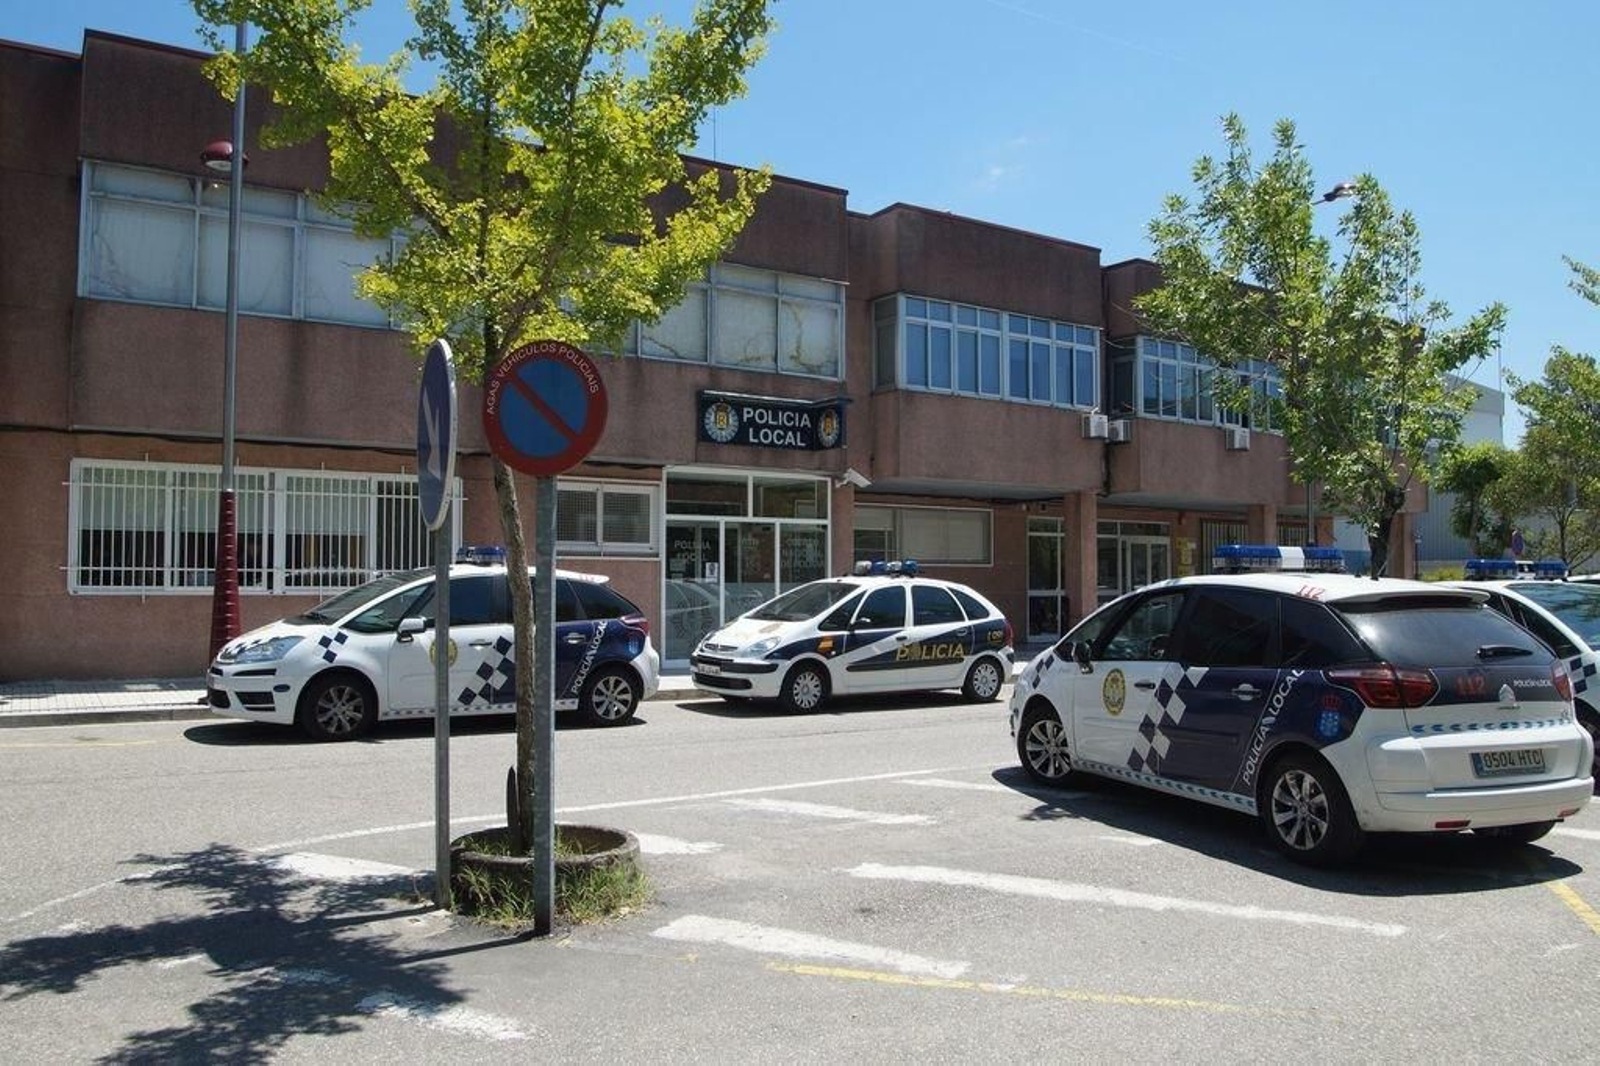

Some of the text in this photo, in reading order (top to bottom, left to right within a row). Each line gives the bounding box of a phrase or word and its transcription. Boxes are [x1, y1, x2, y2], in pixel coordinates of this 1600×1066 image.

[558, 345, 599, 393] POLICIAIS
[743, 407, 812, 428] POLICIA
[749, 427, 806, 446] LOCAL
[1297, 584, 1326, 600] 112
[1268, 669, 1305, 716] LOCAL
[1483, 748, 1541, 768] 0504 HTC
